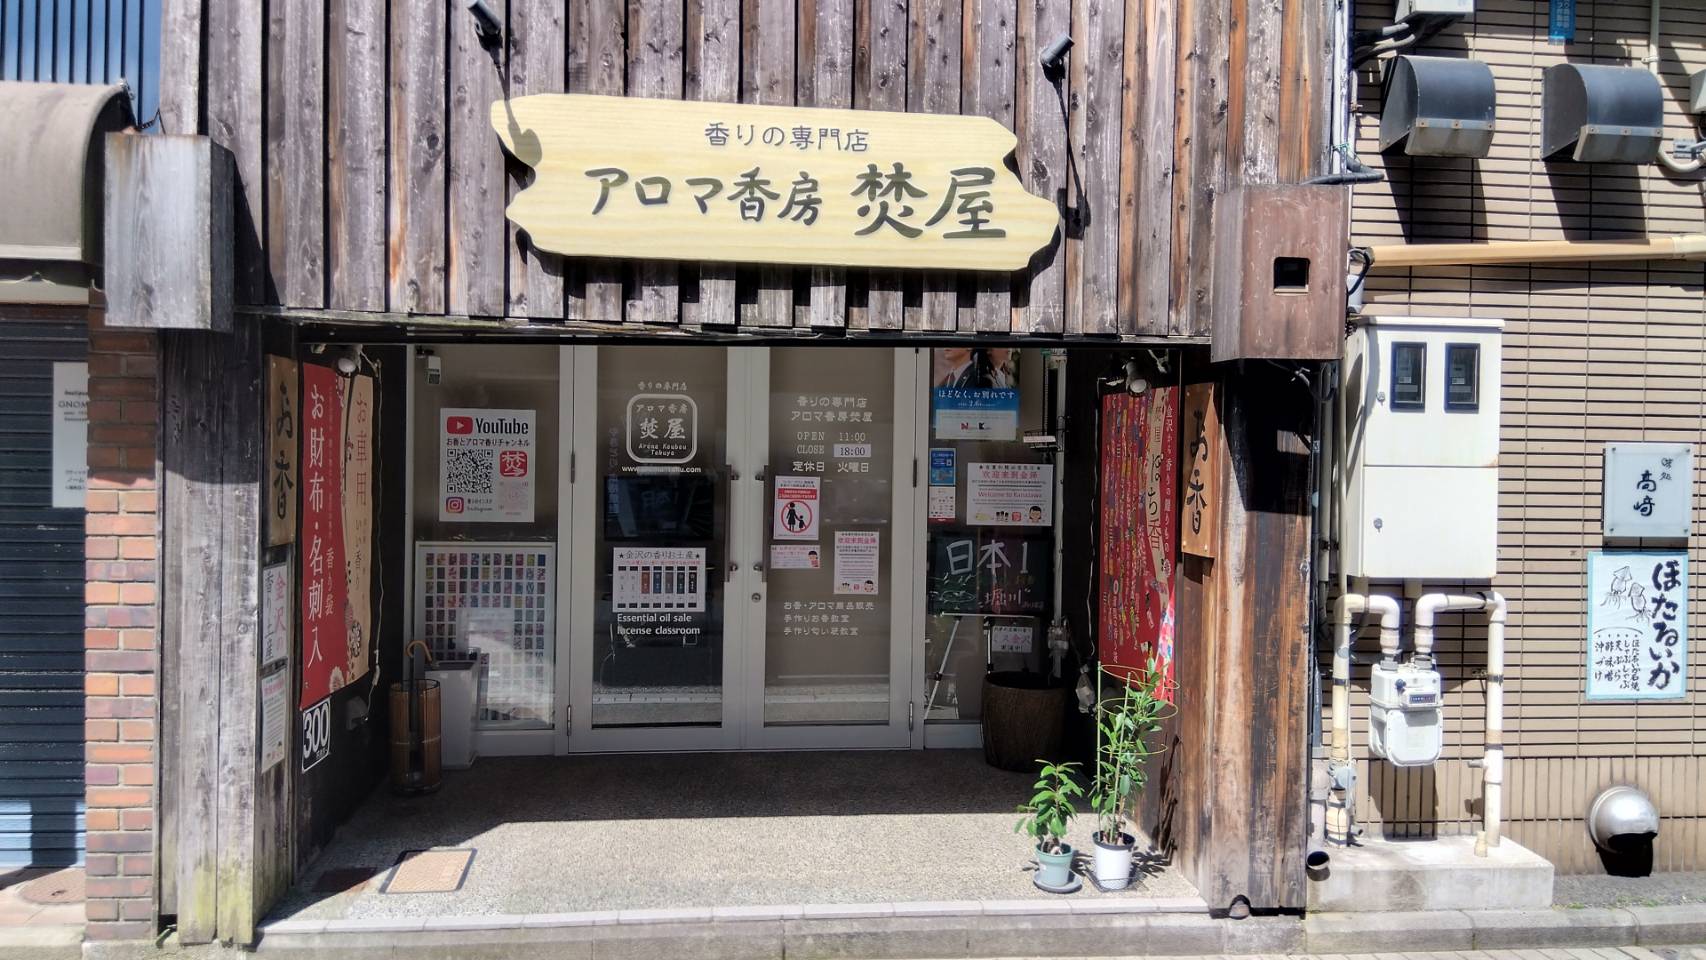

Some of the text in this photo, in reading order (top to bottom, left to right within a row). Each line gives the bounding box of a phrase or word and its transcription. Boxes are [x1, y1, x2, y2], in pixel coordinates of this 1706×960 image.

[703, 122, 871, 152] 香りの専門店
[584, 162, 1007, 239] アロマ香房 焚屋
[797, 395, 868, 408] 香りの専門店
[475, 418, 529, 435] YouTube
[640, 418, 686, 439] 焚屋
[796, 431, 866, 442] OPEN 11:00
[273, 381, 294, 520] お香
[796, 444, 866, 456] CLOSE 18:00
[792, 461, 869, 473] 定休日 火曜日
[1186, 409, 1208, 536] お香
[617, 613, 692, 623] Essential oil sale
[1647, 560, 1681, 690] ほたるいか
[655, 625, 701, 635] classroom
[303, 702, 329, 759] 300
